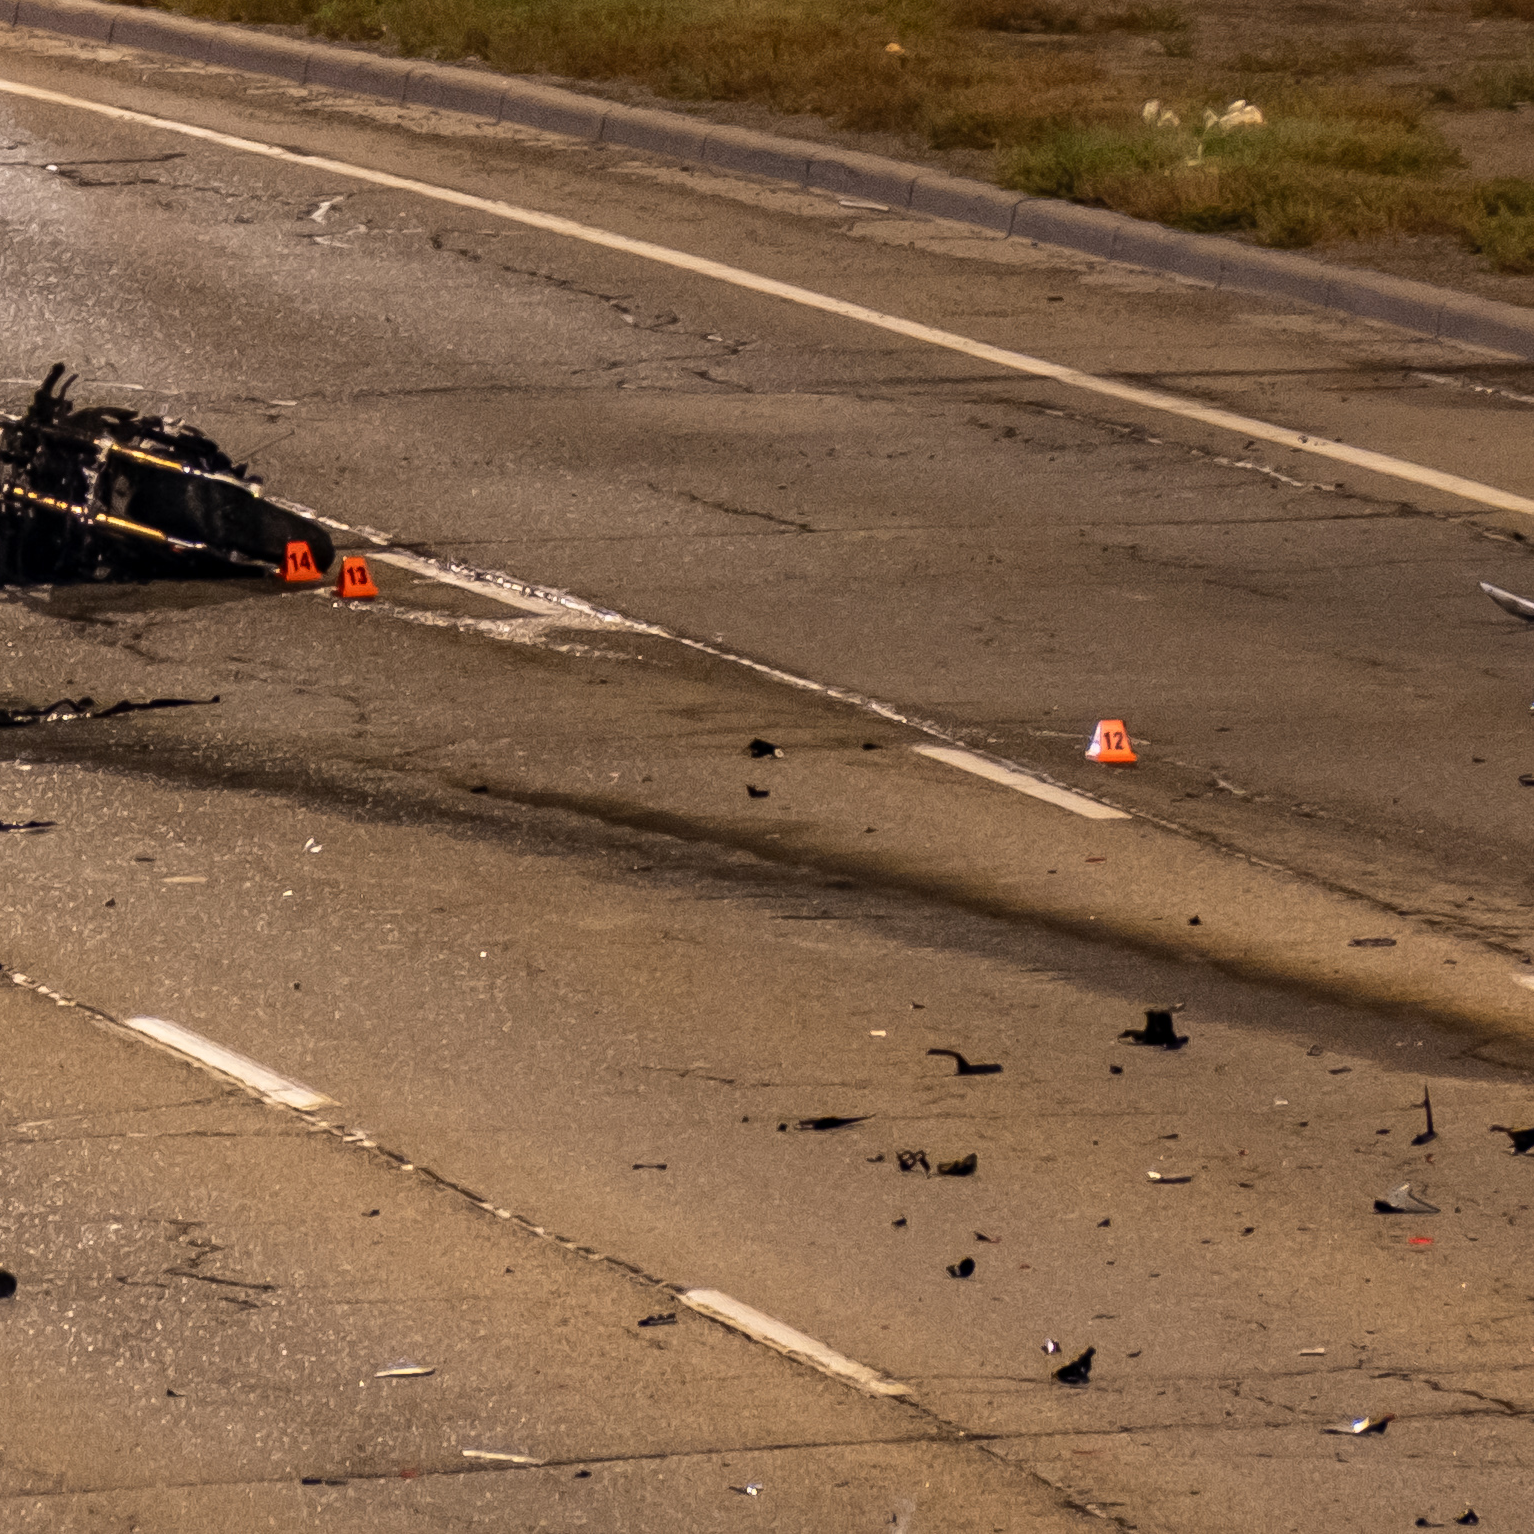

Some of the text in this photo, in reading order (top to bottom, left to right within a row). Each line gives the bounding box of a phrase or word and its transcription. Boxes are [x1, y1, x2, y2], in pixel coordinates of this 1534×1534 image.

[289, 551, 311, 572] 14
[346, 565, 368, 586] 13
[1103, 731, 1125, 751] 12
